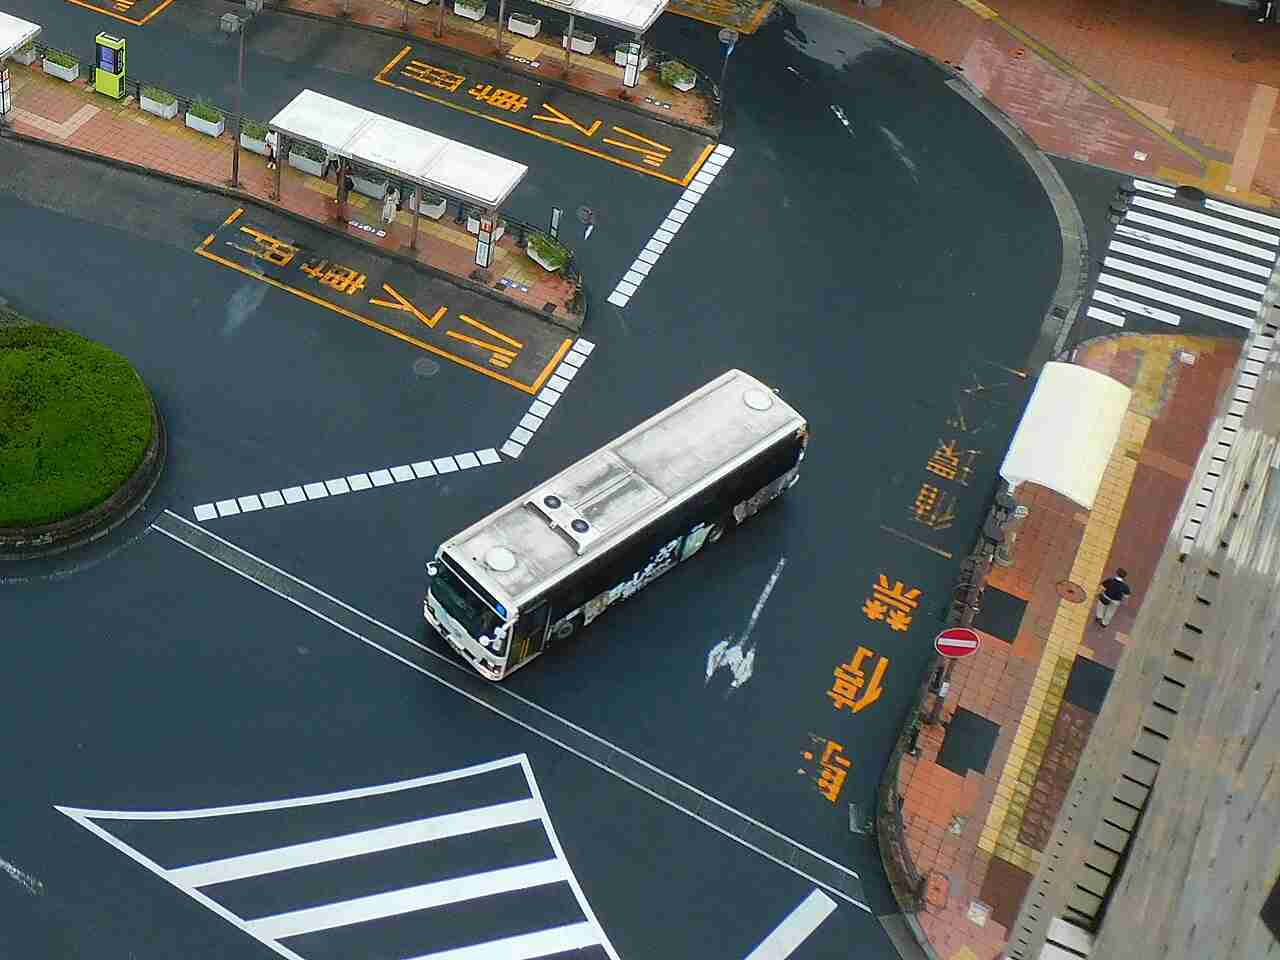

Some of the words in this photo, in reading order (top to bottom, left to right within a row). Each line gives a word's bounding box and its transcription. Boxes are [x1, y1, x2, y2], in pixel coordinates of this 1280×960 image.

[400, 58, 673, 167] バス専用
[224, 224, 524, 369] バス専用
